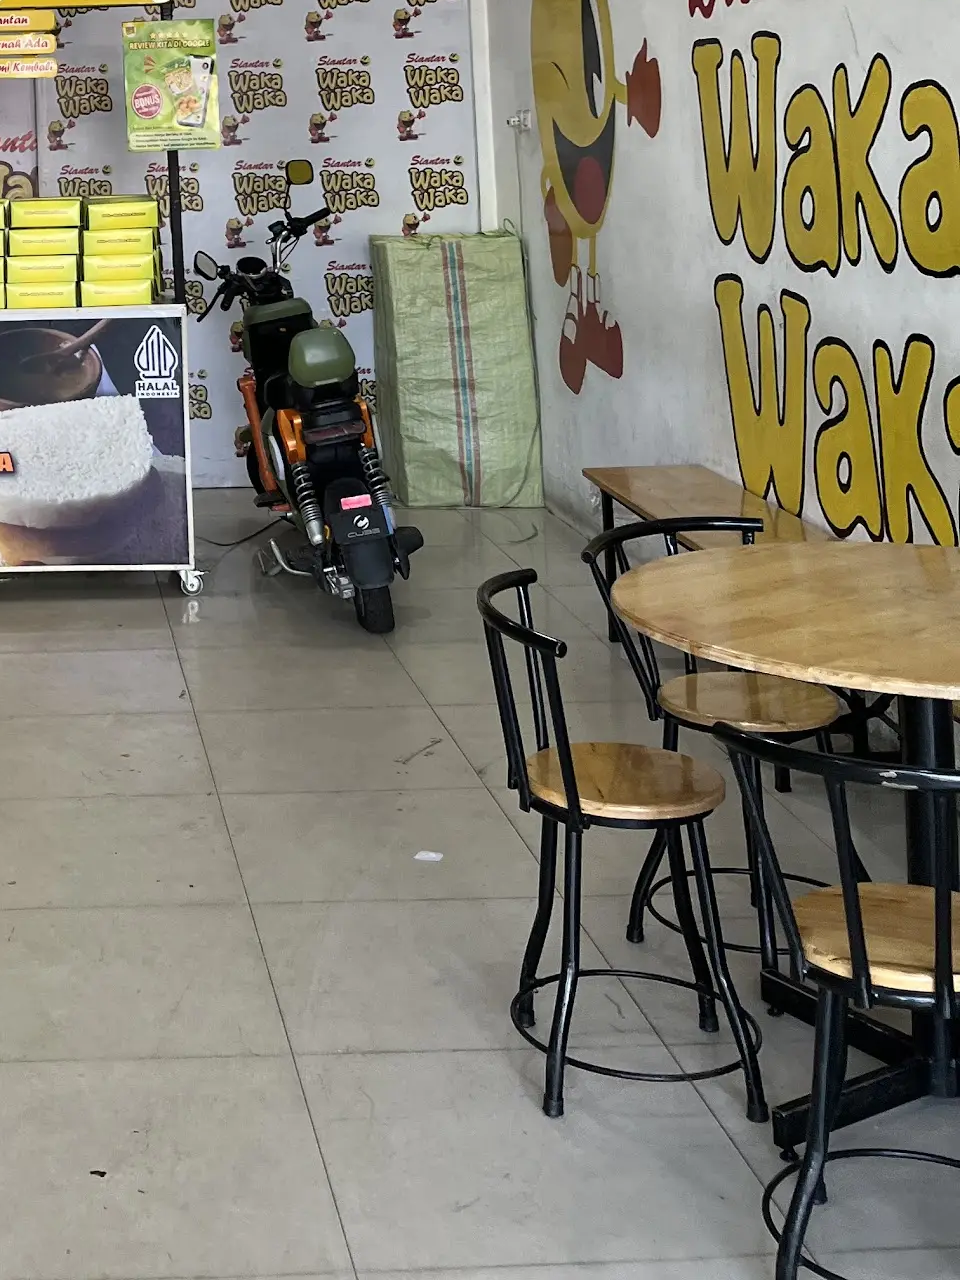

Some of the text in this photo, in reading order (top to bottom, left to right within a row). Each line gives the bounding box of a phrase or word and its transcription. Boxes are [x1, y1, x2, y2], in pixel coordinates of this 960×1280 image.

[24, 37, 48, 48] Ada
[129, 41, 156, 50] REVIEW
[157, 41, 172, 49] KITA
[12, 61, 53, 73] Kembali
[58, 63, 97, 74] Siantar
[230, 58, 270, 69] Siantar
[317, 55, 358, 66] Siantar
[406, 53, 447, 64] Siantar
[55, 75, 108, 98] Waka
[228, 70, 283, 93] Waka
[316, 67, 371, 91] Waka
[404, 65, 460, 88] Waka
[58, 94, 113, 118] Waka
[134, 95, 160, 109] BONUS
[231, 89, 287, 113] Waka
[320, 86, 375, 111] Waka
[408, 84, 464, 109] Waka
[234, 160, 274, 171] Siantar
[322, 157, 363, 169] Siantar
[410, 155, 451, 166] Siantar
[691, 30, 960, 278] Waka
[60, 165, 100, 175] Siantar
[320, 169, 376, 192] Waka
[408, 167, 464, 190] Waka
[232, 172, 288, 195] Waka
[324, 188, 379, 213] Waka
[413, 186, 469, 211] Waka
[326, 260, 367, 271] Siantar
[138, 381, 178, 391] HALAL
[713, 272, 960, 547] Wak
